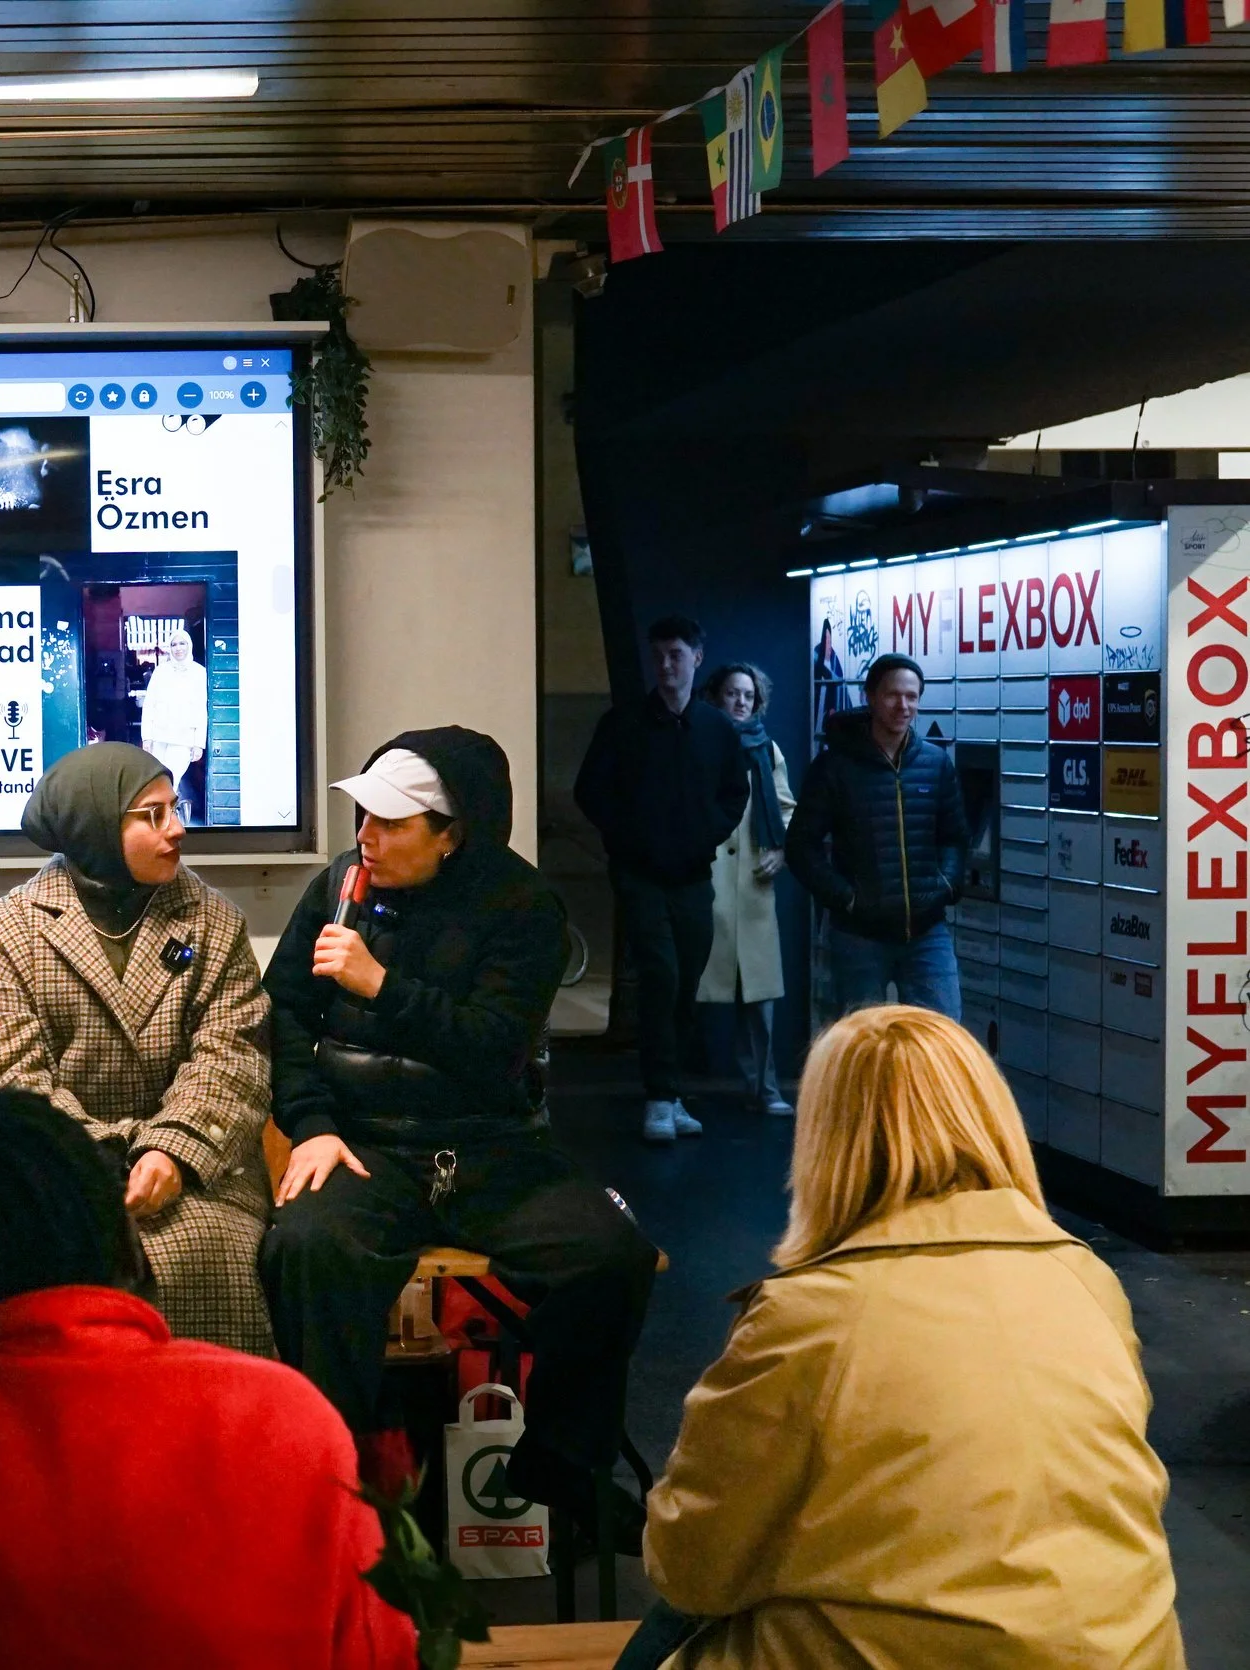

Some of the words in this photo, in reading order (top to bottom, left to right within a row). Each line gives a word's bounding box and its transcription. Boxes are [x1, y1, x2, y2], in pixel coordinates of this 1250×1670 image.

[208, 390, 235, 401] 100%
[97, 470, 162, 496] Esra
[96, 496, 209, 530] Özmen
[1072, 696, 1091, 724] dpd
[1114, 838, 1148, 868] FedEx
[1186, 575, 1249, 1164] MYFLEXBOX
[1110, 912, 1151, 940] alzaBox
[462, 1529, 541, 1544] SPAR
